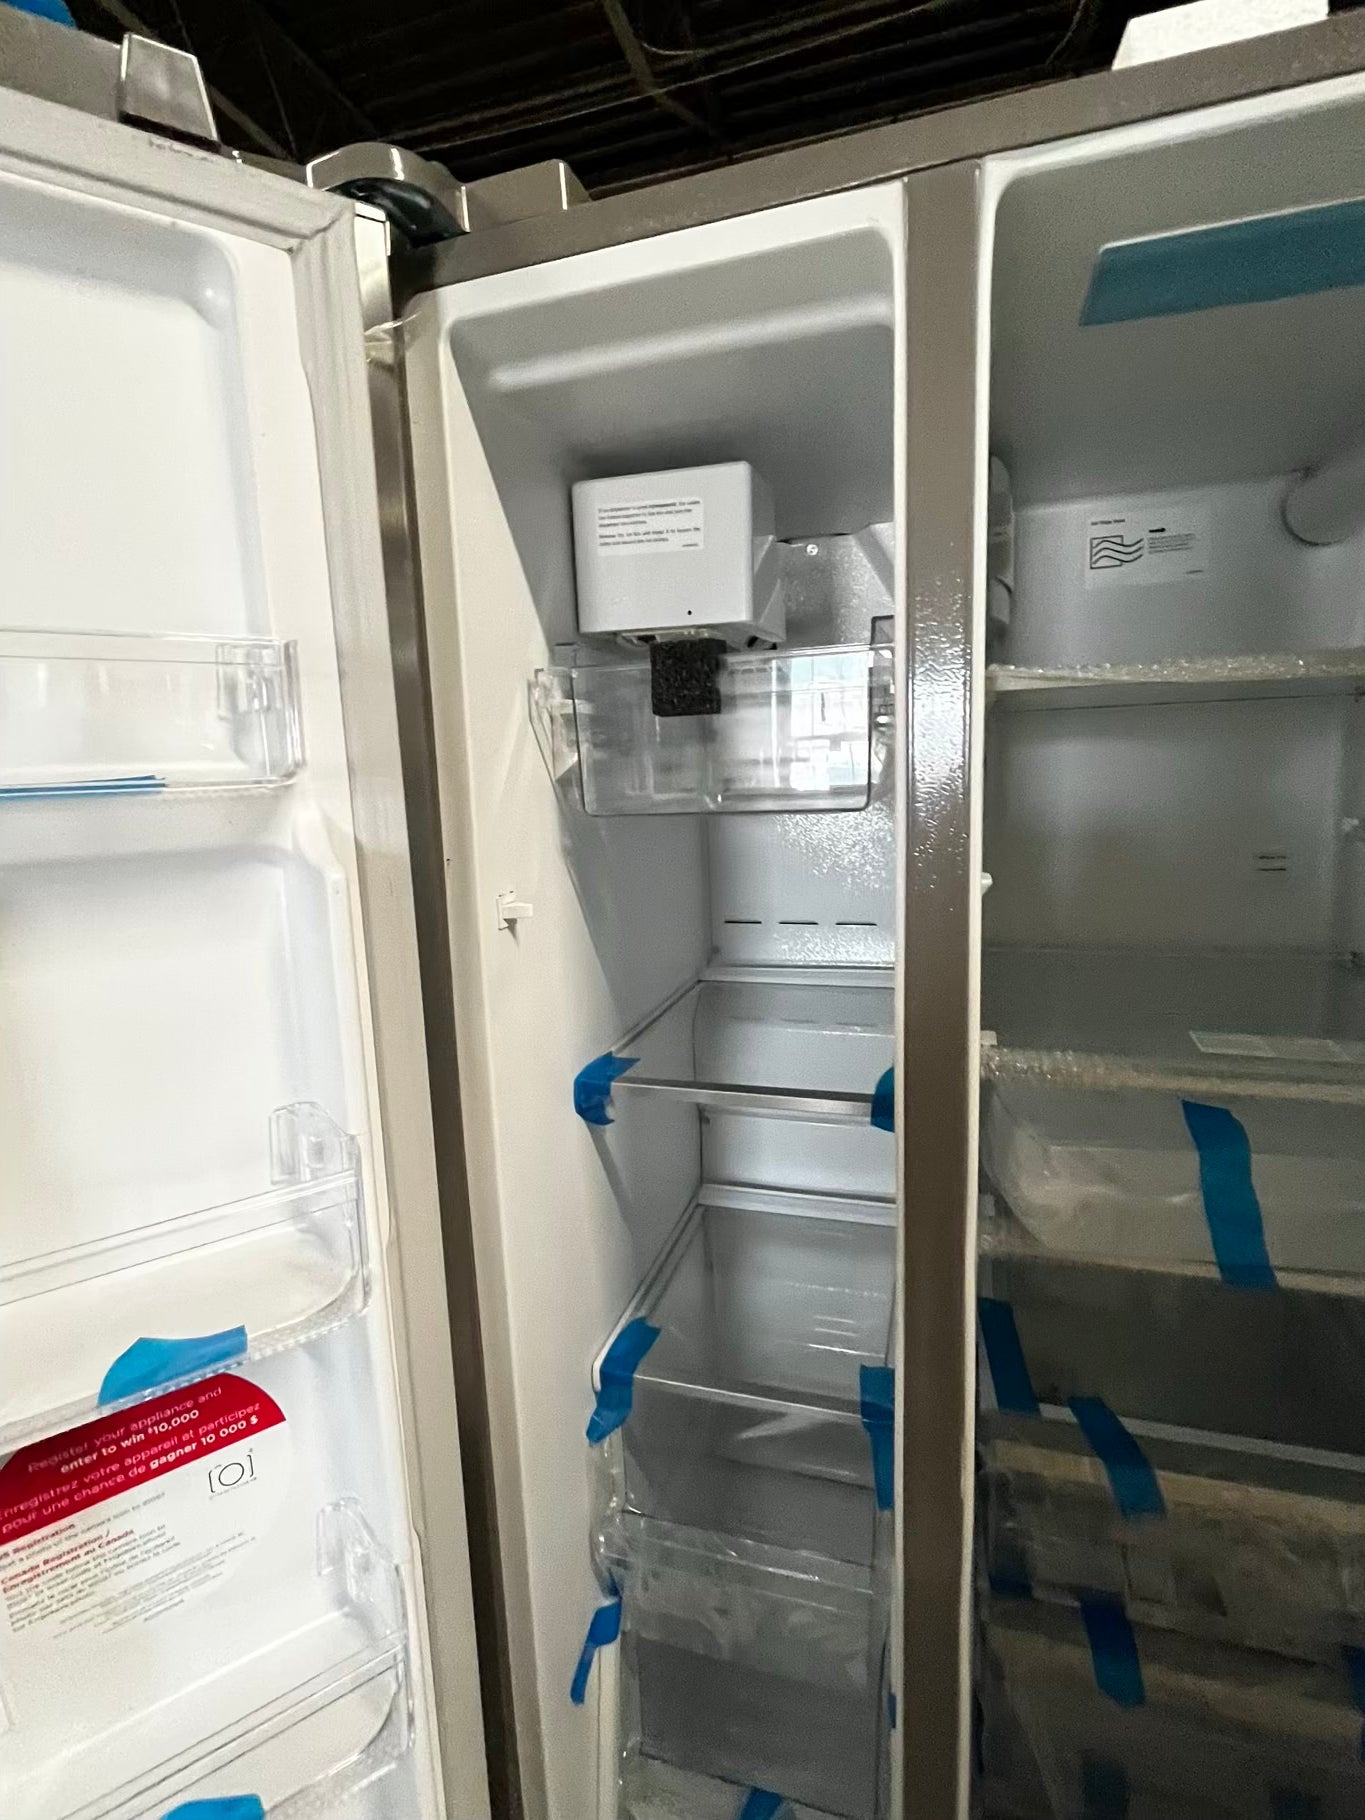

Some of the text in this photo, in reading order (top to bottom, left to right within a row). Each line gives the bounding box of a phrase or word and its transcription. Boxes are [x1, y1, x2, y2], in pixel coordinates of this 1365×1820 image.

[28, 1387, 222, 1473] Register your appliance and
[60, 1409, 200, 1474] enter to win $10,000
[83, 1463, 120, 1483] votre
[124, 1437, 179, 1466] appareil
[181, 1429, 195, 1441] et
[199, 1403, 261, 1435] participez
[2, 1511, 39, 1534] pour
[42, 1499, 70, 1514] une
[74, 1474, 125, 1501] chance
[129, 1464, 146, 1478] de
[149, 1442, 198, 1469] gagner
[201, 1434, 216, 1446] 10
[219, 1421, 247, 1437] 000
[250, 1415, 260, 1425] $
[43, 1534, 103, 1566] Registration
[98, 1529, 134, 1548] Canada
